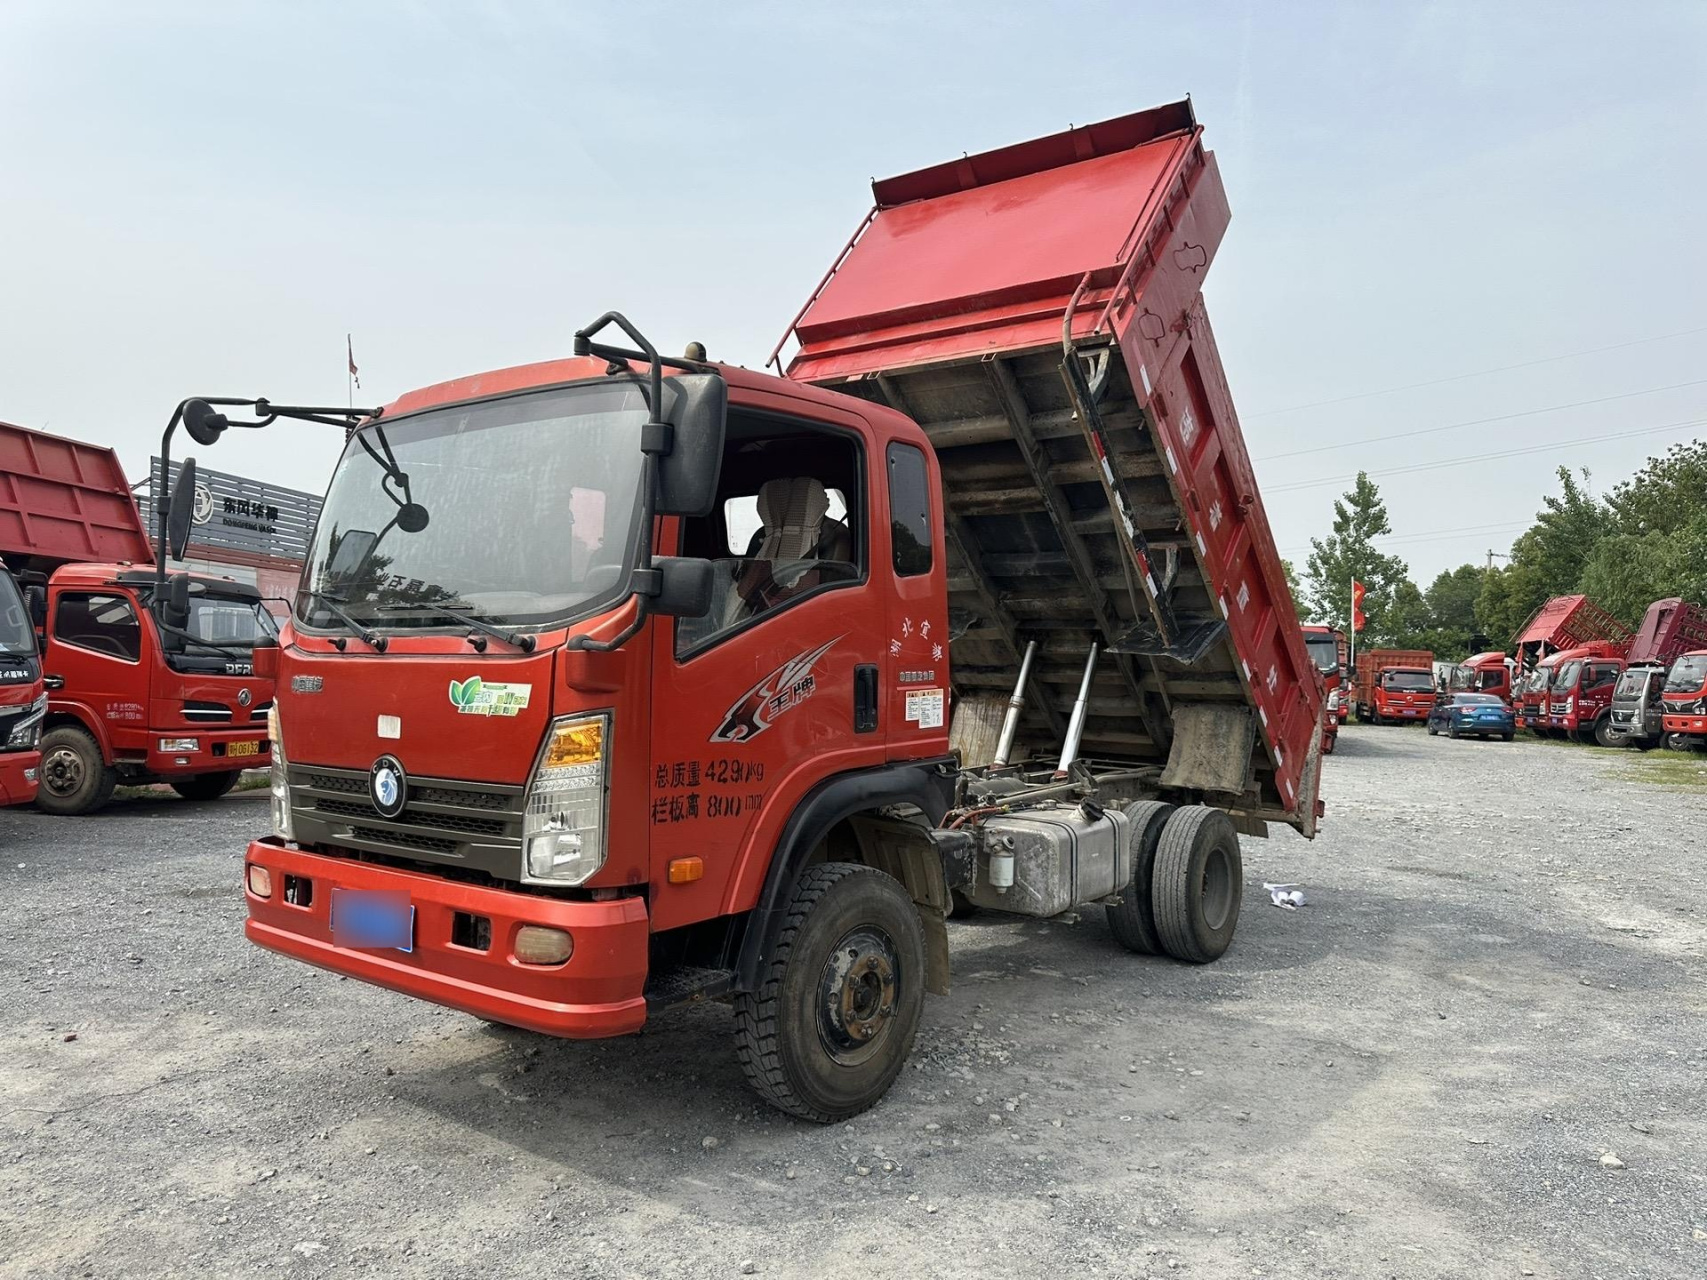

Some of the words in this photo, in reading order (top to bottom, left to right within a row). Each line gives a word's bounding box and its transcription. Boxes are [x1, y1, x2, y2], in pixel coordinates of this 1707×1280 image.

[223, 497, 279, 522] 东风华神
[223, 518, 258, 531] DONGFENG
[767, 674, 816, 722] 王牌
[372, 759, 401, 777] CDW
[655, 760, 702, 788] 总质量
[651, 791, 701, 826] 栏板高
